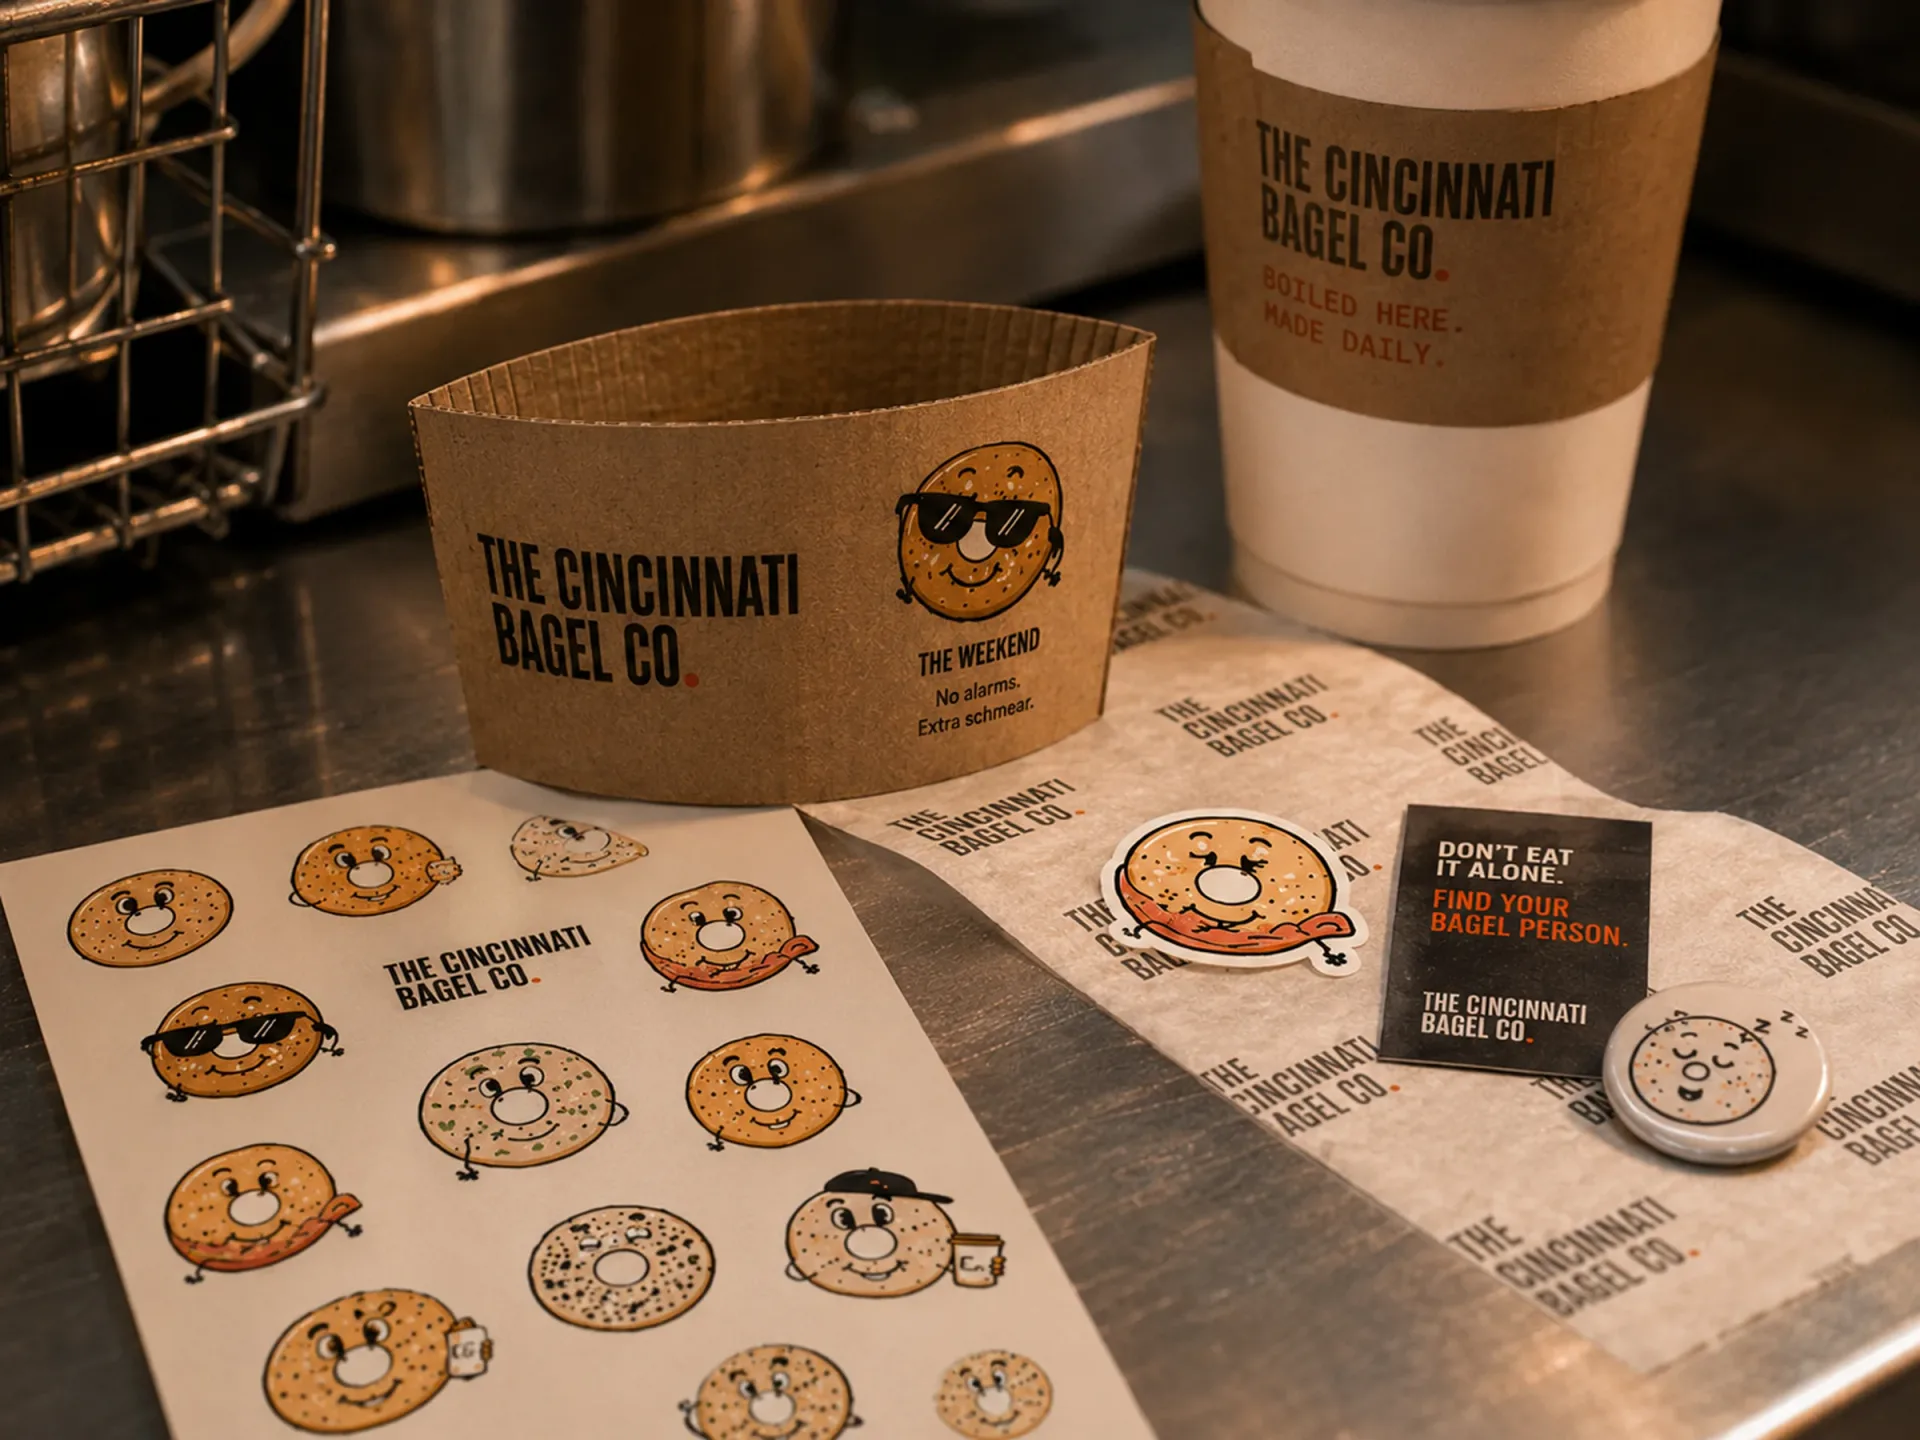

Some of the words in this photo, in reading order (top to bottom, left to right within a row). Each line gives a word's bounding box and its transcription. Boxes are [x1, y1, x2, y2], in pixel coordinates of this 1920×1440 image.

[1256, 119, 1311, 194] THE
[1325, 145, 1555, 220] CINCINNATI
[1261, 182, 1367, 271] BAGEL
[1381, 220, 1450, 280] CO.
[1263, 265, 1357, 317] BOILED
[1377, 301, 1463, 333] HERE.
[1265, 302, 1324, 344] MADE
[1343, 329, 1444, 368] DAILY.
[477, 532, 546, 605] THE
[555, 548, 799, 618] CINCINNATI
[492, 602, 614, 683] BAGEL
[624, 623, 699, 688] CO.
[918, 648, 953, 677] THE
[958, 627, 1040, 669] WEEKEND
[936, 688, 959, 707] No
[964, 677, 1022, 702] alarms.
[1153, 696, 1211, 723] THE
[1182, 673, 1329, 740] CINCINNATI
[918, 717, 960, 737] Extra
[965, 697, 1034, 727] schmear.
[1206, 719, 1295, 758] BAGEL
[1283, 704, 1340, 729] CO.
[1411, 716, 1468, 746] THE
[1466, 747, 1550, 785] BAGEL
[885, 808, 948, 831] THE
[916, 778, 1076, 842] CINCINNATI
[939, 819, 1035, 857] BAGEL
[1024, 804, 1085, 826] CO.
[1436, 859, 1461, 877] IT
[1468, 863, 1563, 884] ALONE.
[1438, 841, 1518, 862] DON'T
[1526, 847, 1574, 866] EAT
[1433, 889, 1491, 911] FIND
[1501, 894, 1569, 918] YOUR
[1735, 896, 1797, 930] THE
[1431, 912, 1510, 937] BAGEL
[1519, 918, 1628, 947] PERSON.
[383, 957, 437, 985] THE
[439, 925, 591, 974] CINCINNATI
[1800, 931, 1890, 978] BAGEL
[395, 972, 487, 1011] BAGEL
[488, 963, 541, 990] CO.
[1423, 991, 1460, 1013] THE
[1466, 994, 1587, 1025] CINCINNATI
[1421, 1012, 1488, 1039] BAGEL
[1496, 1019, 1534, 1044] CO.
[1200, 1057, 1259, 1092] THE
[1337, 1073, 1400, 1104] CO.
[1445, 1214, 1525, 1262] THE
[1495, 1196, 1677, 1290] CINCINNATI
[1535, 1259, 1646, 1319] BAGEL
